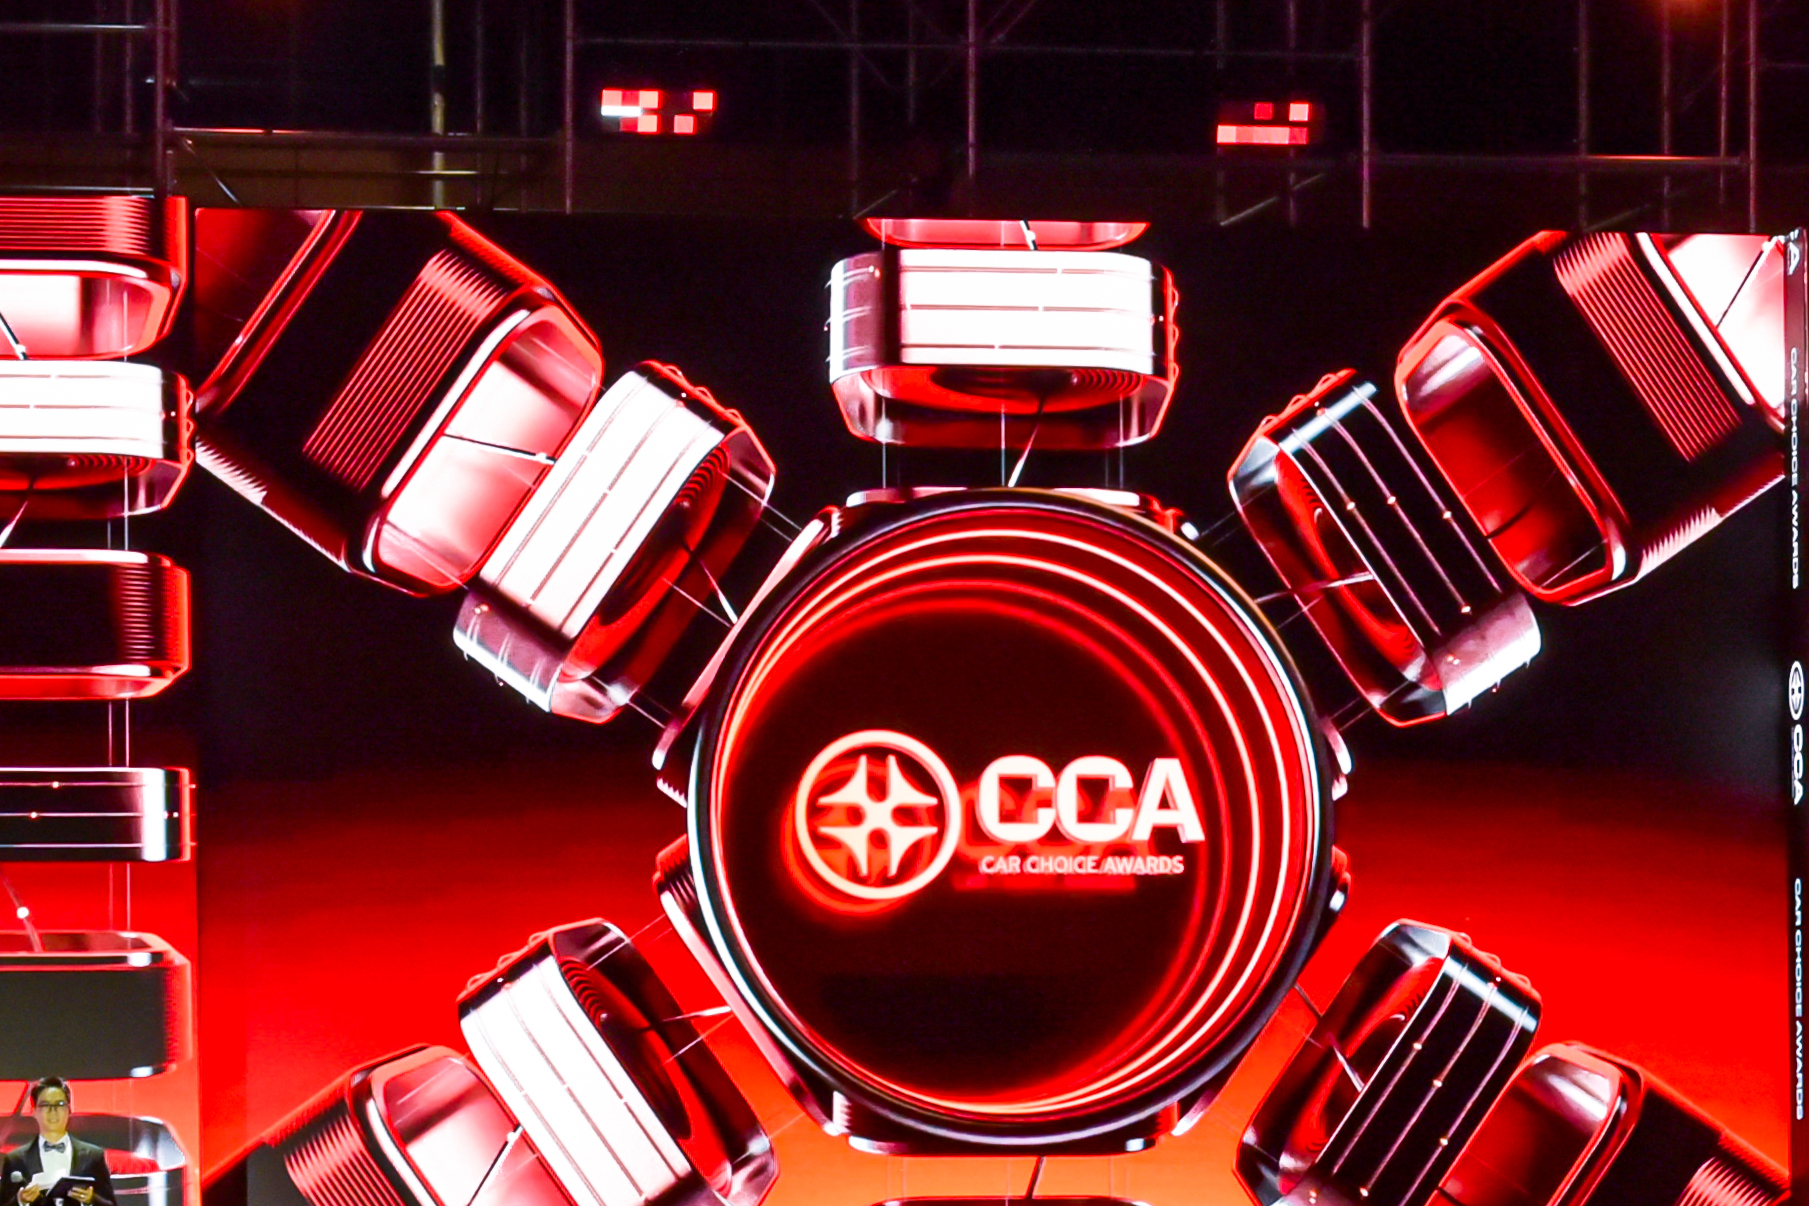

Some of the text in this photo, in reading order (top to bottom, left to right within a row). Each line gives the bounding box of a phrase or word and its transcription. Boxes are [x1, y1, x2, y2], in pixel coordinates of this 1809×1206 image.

[1791, 489, 1799, 589] AWARDS
[976, 754, 1206, 843] CCA
[1794, 724, 1804, 805] CCA
[979, 855, 1185, 875] CAR CHOICE AWARDS
[1795, 929, 1803, 1017] CHOICE
[1795, 1020, 1804, 1120] AWARDS
